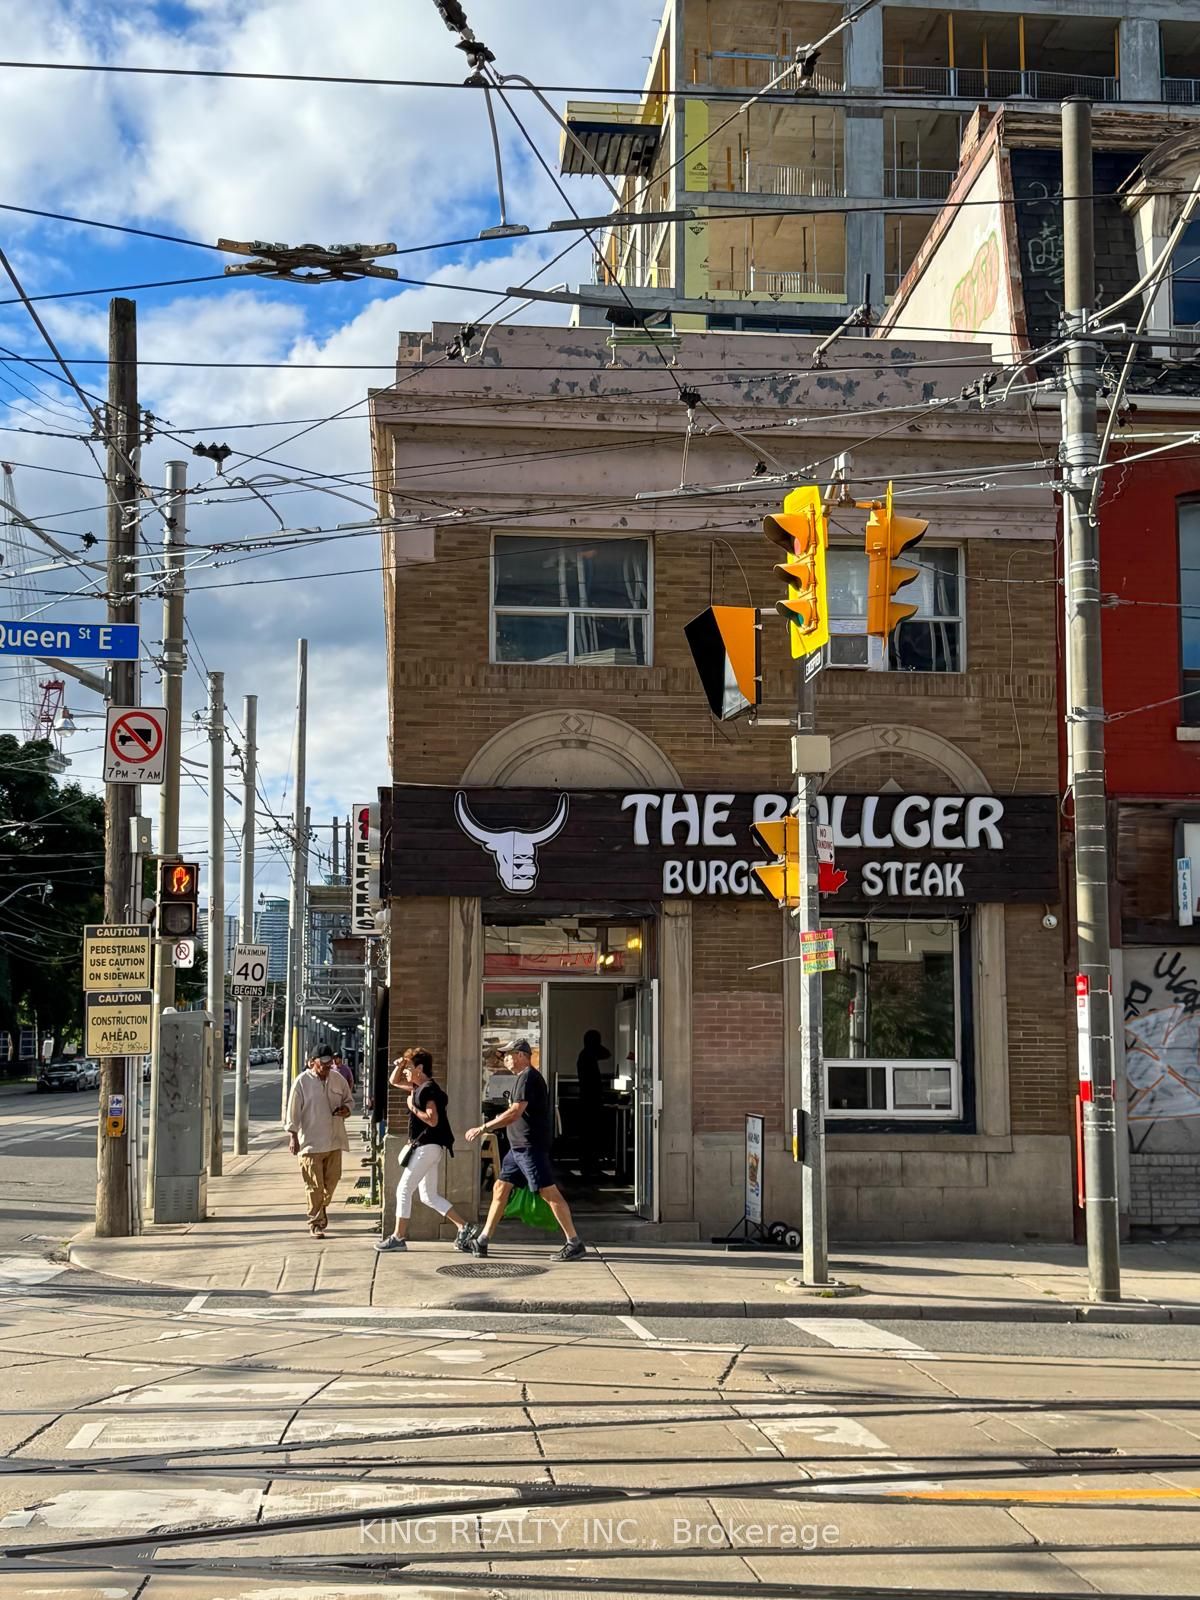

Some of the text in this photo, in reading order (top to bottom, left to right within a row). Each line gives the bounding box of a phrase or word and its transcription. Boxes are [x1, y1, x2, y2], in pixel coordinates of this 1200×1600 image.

[78, 627, 91, 640] St
[98, 627, 113, 650] E
[621, 793, 736, 847] THE
[861, 861, 966, 897] STEAK
[96, 927, 141, 937] CAUTION
[90, 944, 146, 955] PEDESTRIANS
[237, 949, 267, 957] MAXIMUM
[90, 958, 145, 967] USE CAUTION
[89, 971, 145, 981] ON SIDEWALK
[236, 962, 265, 982] 40
[233, 985, 263, 996] BEGINS
[98, 994, 142, 1004] CAUTION
[495, 1007, 539, 1017] SAVE BIG
[91, 1015, 148, 1026] CONSTRUCTION
[101, 1030, 138, 1042] AHEAD
